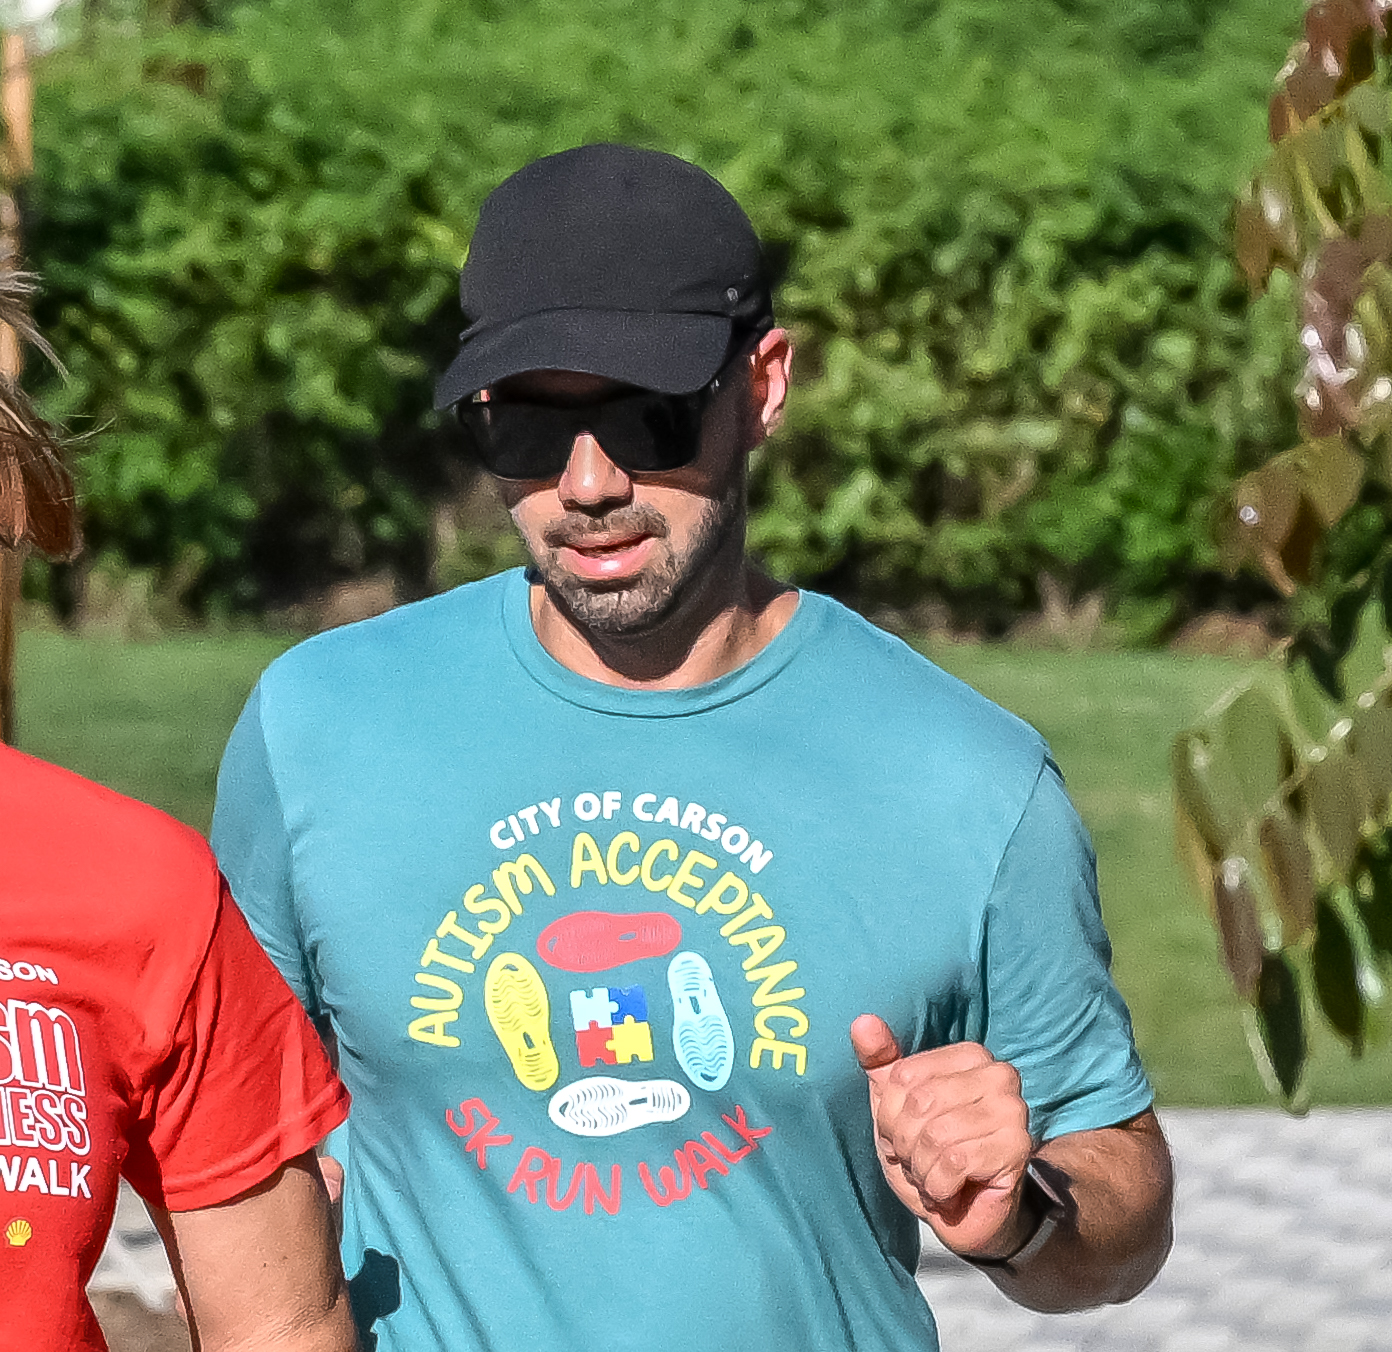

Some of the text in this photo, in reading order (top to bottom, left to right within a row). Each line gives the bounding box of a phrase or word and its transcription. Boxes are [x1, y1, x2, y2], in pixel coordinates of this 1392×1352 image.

[489, 791, 774, 874] CITY OF CARSON
[407, 831, 809, 1076] AUTISM ACCEPTANCE
[445, 1097, 773, 1215] 5K RUN WALK
